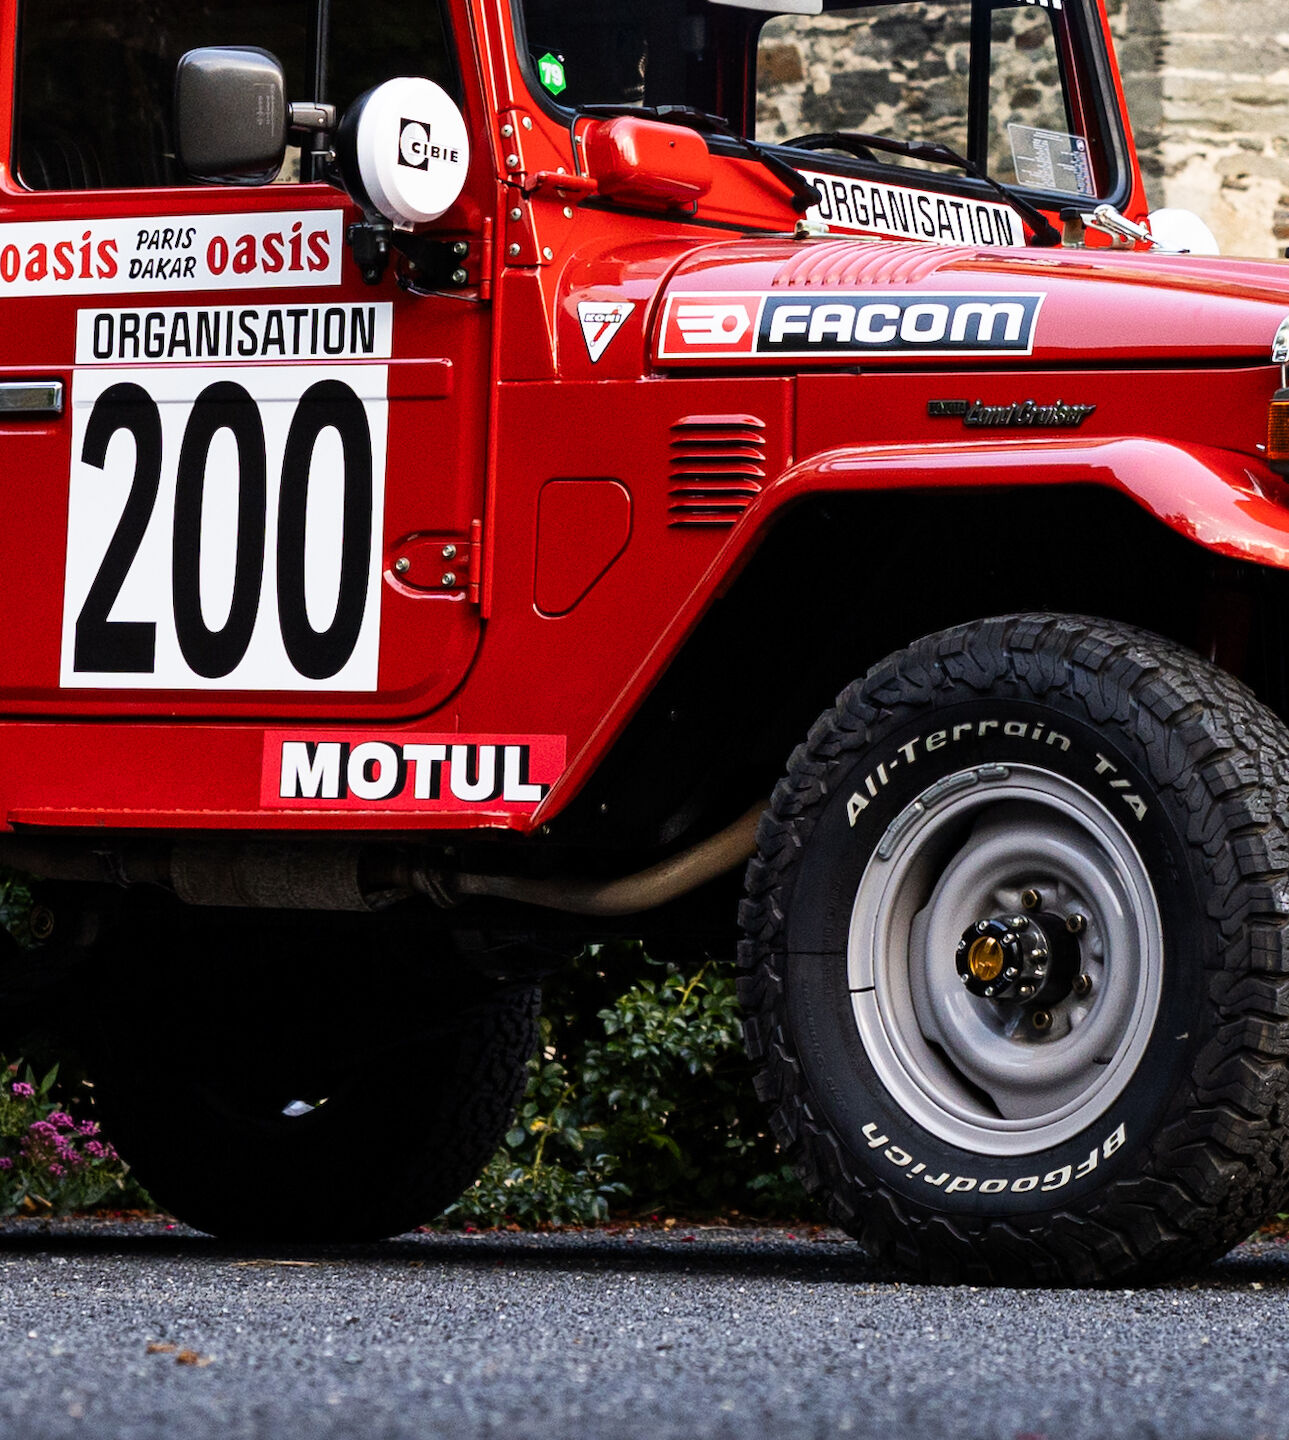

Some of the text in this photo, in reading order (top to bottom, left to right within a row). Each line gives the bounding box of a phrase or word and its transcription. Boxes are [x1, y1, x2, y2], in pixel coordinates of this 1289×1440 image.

[541, 61, 563, 86] 79
[136, 227, 196, 251] PARIS
[813, 177, 1014, 246] ORGANISATION
[0, 229, 118, 283] oasis
[128, 256, 197, 280] DAKAR
[206, 220, 330, 276] oasis
[92, 306, 376, 360] ORGANISATION
[768, 300, 1026, 344] FACOM
[72, 378, 374, 680] 200
[279, 740, 550, 803] MOTUL
[845, 719, 1149, 828] All-Terrain T/A
[859, 1122, 1129, 1196] BFGoodrich
